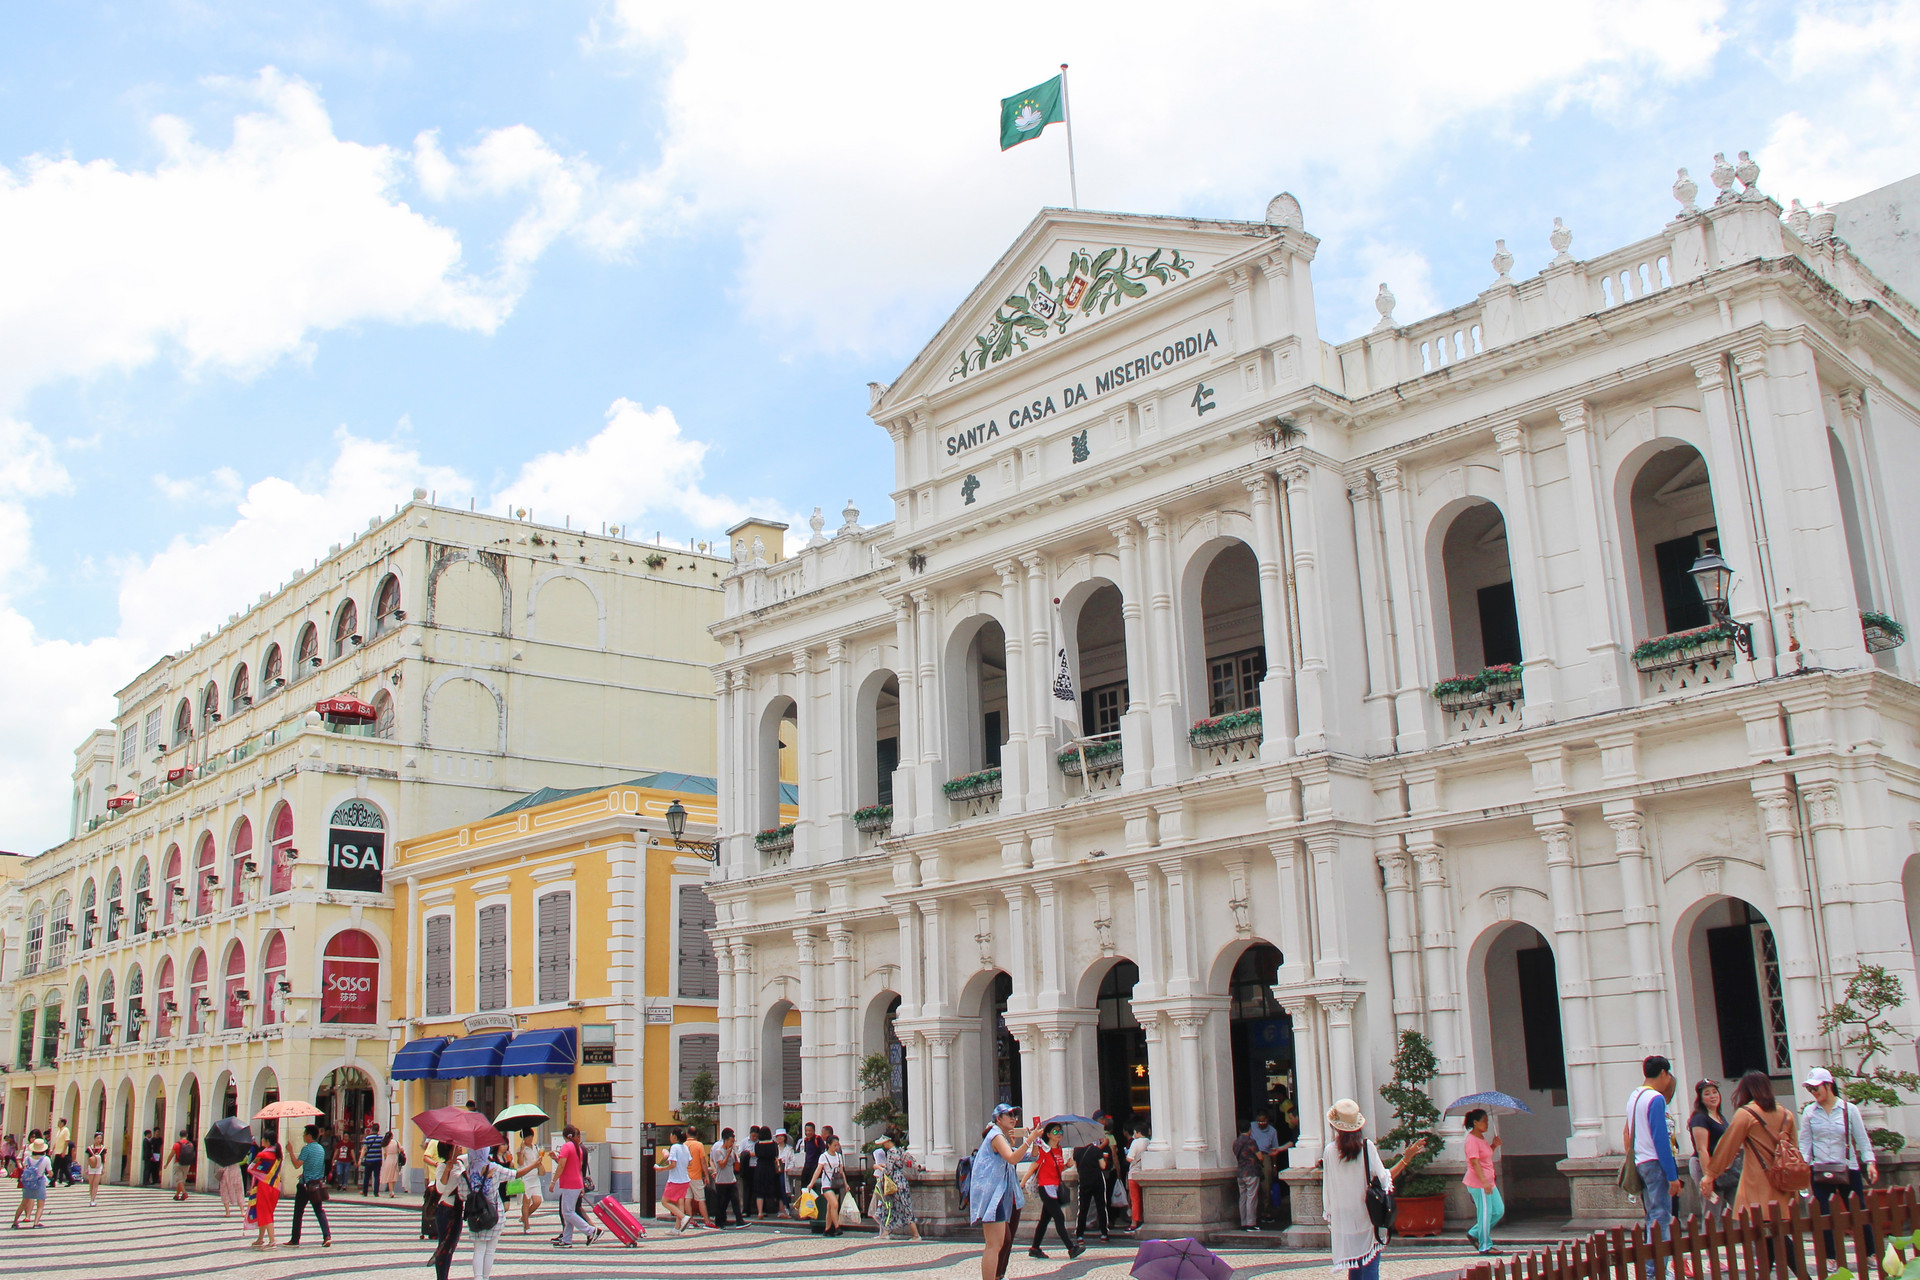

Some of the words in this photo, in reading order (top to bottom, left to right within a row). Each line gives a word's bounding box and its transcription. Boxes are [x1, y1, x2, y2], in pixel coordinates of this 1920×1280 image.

[946, 419, 1000, 456] SANTA
[1008, 395, 1057, 430] CASA
[1063, 383, 1088, 408] DA
[1095, 328, 1219, 396] MISERICORDIA
[1190, 382, 1217, 417] 仁
[960, 473, 981, 506] 堂
[335, 702, 351, 711] ISA
[358, 704, 371, 715] ISA
[332, 843, 381, 871] ISA
[110, 911, 119, 933] IS
[137, 902, 147, 925] IS
